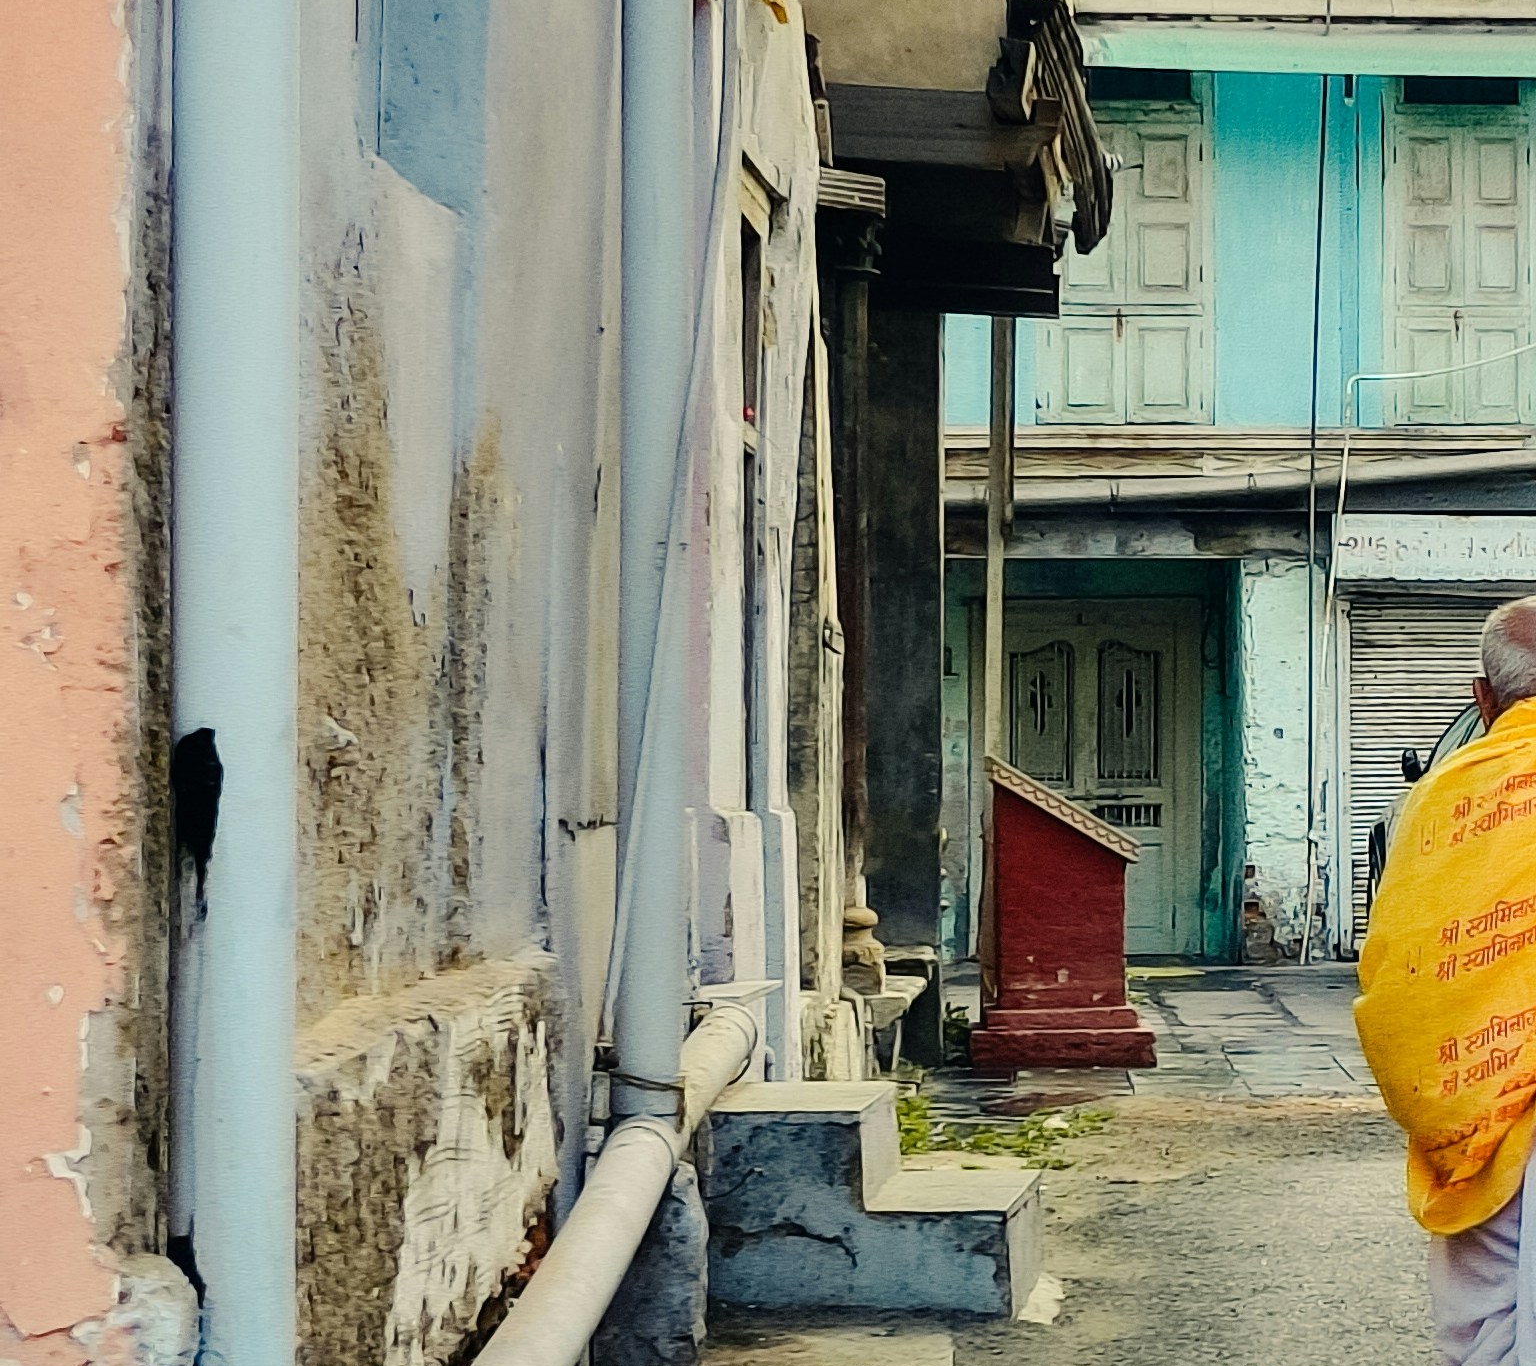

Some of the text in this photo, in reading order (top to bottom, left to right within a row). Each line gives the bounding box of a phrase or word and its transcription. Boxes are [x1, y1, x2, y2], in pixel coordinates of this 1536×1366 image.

[1437, 919, 1460, 948] श्री
[1436, 953, 1457, 982] श्री
[1438, 1036, 1459, 1065] श्री
